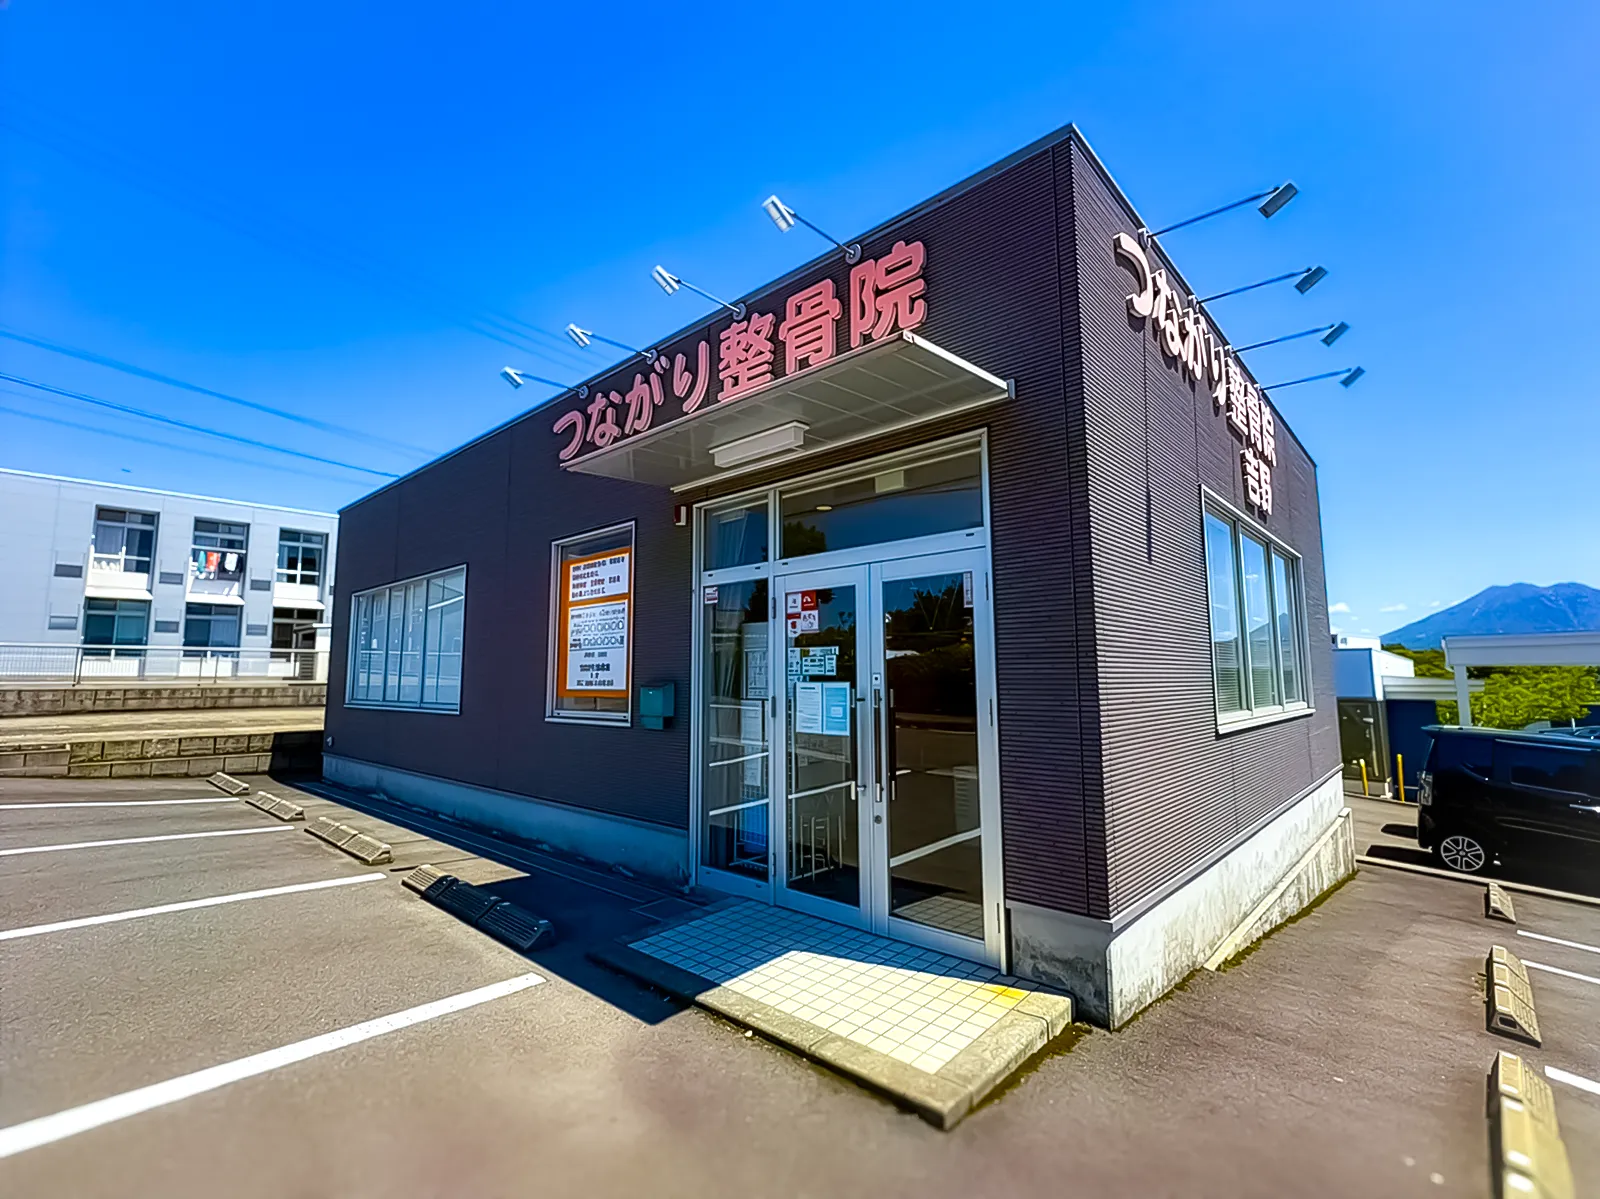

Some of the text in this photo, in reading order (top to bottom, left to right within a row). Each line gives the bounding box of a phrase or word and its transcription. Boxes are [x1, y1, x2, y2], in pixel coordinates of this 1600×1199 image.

[553, 240, 927, 460] つながり整骨院
[1113, 231, 1276, 467] つながり整骨院
